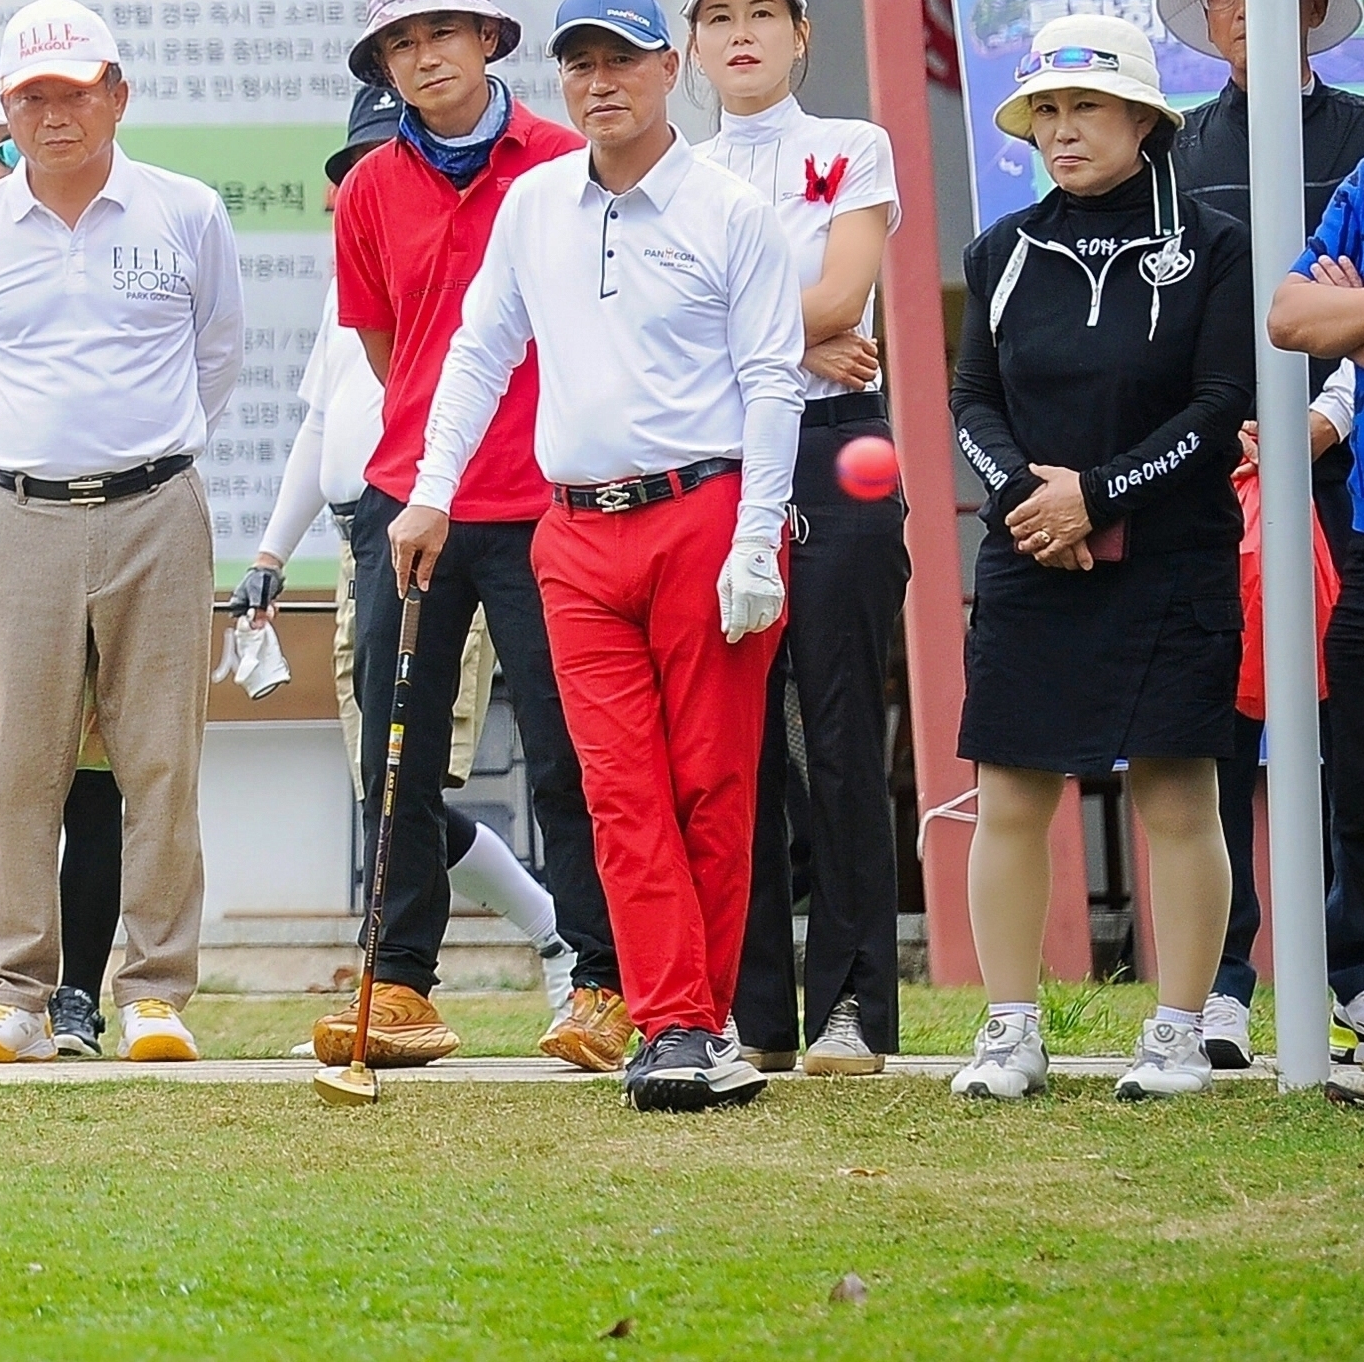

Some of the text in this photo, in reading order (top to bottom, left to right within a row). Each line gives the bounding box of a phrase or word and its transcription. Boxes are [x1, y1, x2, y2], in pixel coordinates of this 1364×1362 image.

[20, 23, 73, 49] ELLE
[20, 41, 72, 59] PARKGOLF
[113, 246, 182, 274] ELLE
[113, 270, 181, 294] SPORT
[126, 291, 171, 301] PARK GOLF
